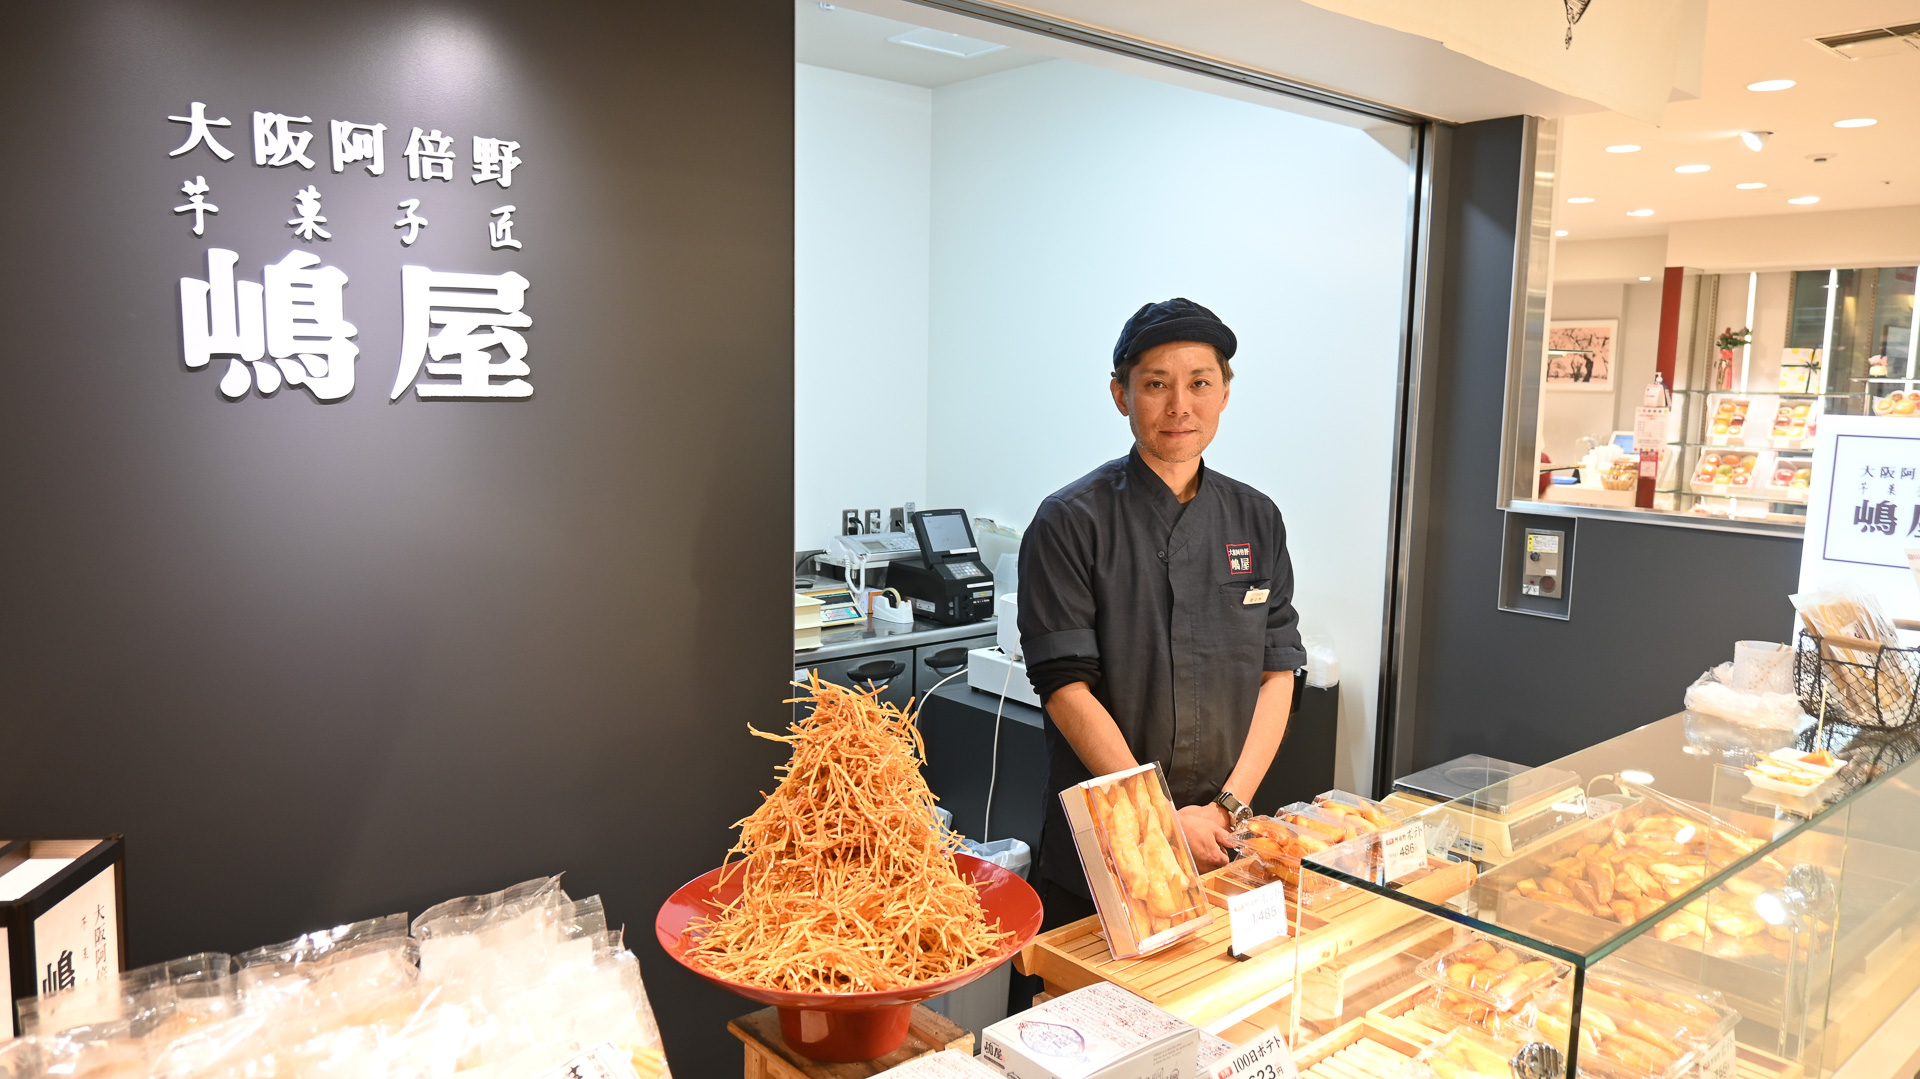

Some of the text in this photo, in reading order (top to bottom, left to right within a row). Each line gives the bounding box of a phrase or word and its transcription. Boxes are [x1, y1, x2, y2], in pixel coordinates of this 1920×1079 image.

[167, 101, 523, 188] 大阪阿倍野
[173, 175, 523, 250] 芋菓子匠
[179, 247, 535, 401] 嶋屋
[1859, 465, 1916, 480] 大阪阿
[1232, 1035, 1281, 1074] 100日ポテト
